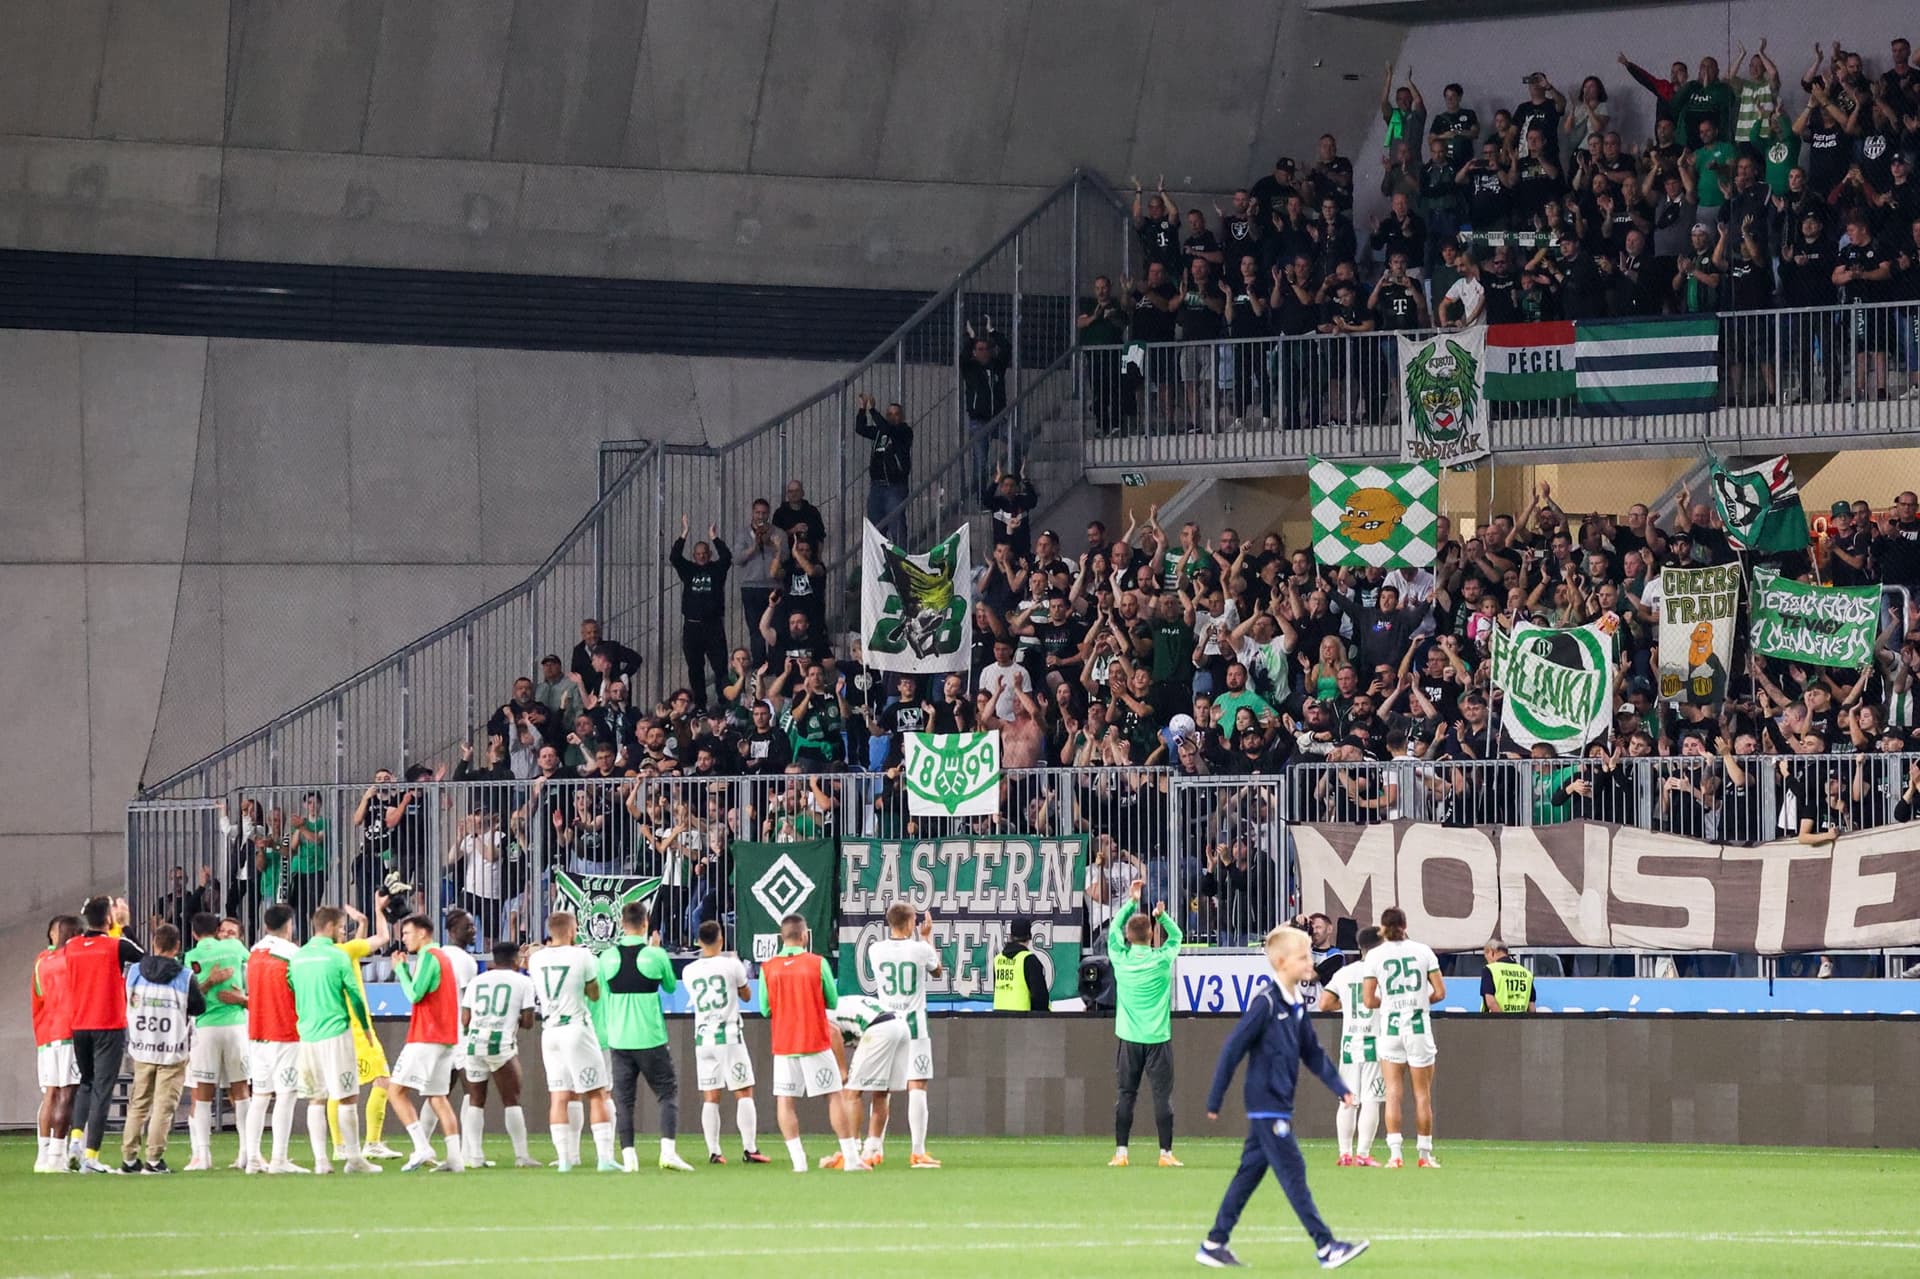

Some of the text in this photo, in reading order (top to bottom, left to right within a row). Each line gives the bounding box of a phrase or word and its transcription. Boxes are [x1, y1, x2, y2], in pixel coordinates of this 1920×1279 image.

[1508, 347, 1564, 374] PÉCEL
[1662, 564, 1740, 597] CHEERS
[1667, 592, 1736, 625] FRADI
[1778, 612, 1845, 635] TE VAGY
[840, 839, 1082, 914] EASTERN
[541, 965, 571, 1001] 17
[879, 961, 917, 996] 30
[996, 968, 1015, 981] 1885
[1383, 956, 1422, 995] 25
[1505, 978, 1527, 992] 1175
[474, 983, 512, 1017] 50
[692, 974, 729, 1012] 23
[1183, 974, 1225, 1013] V3
